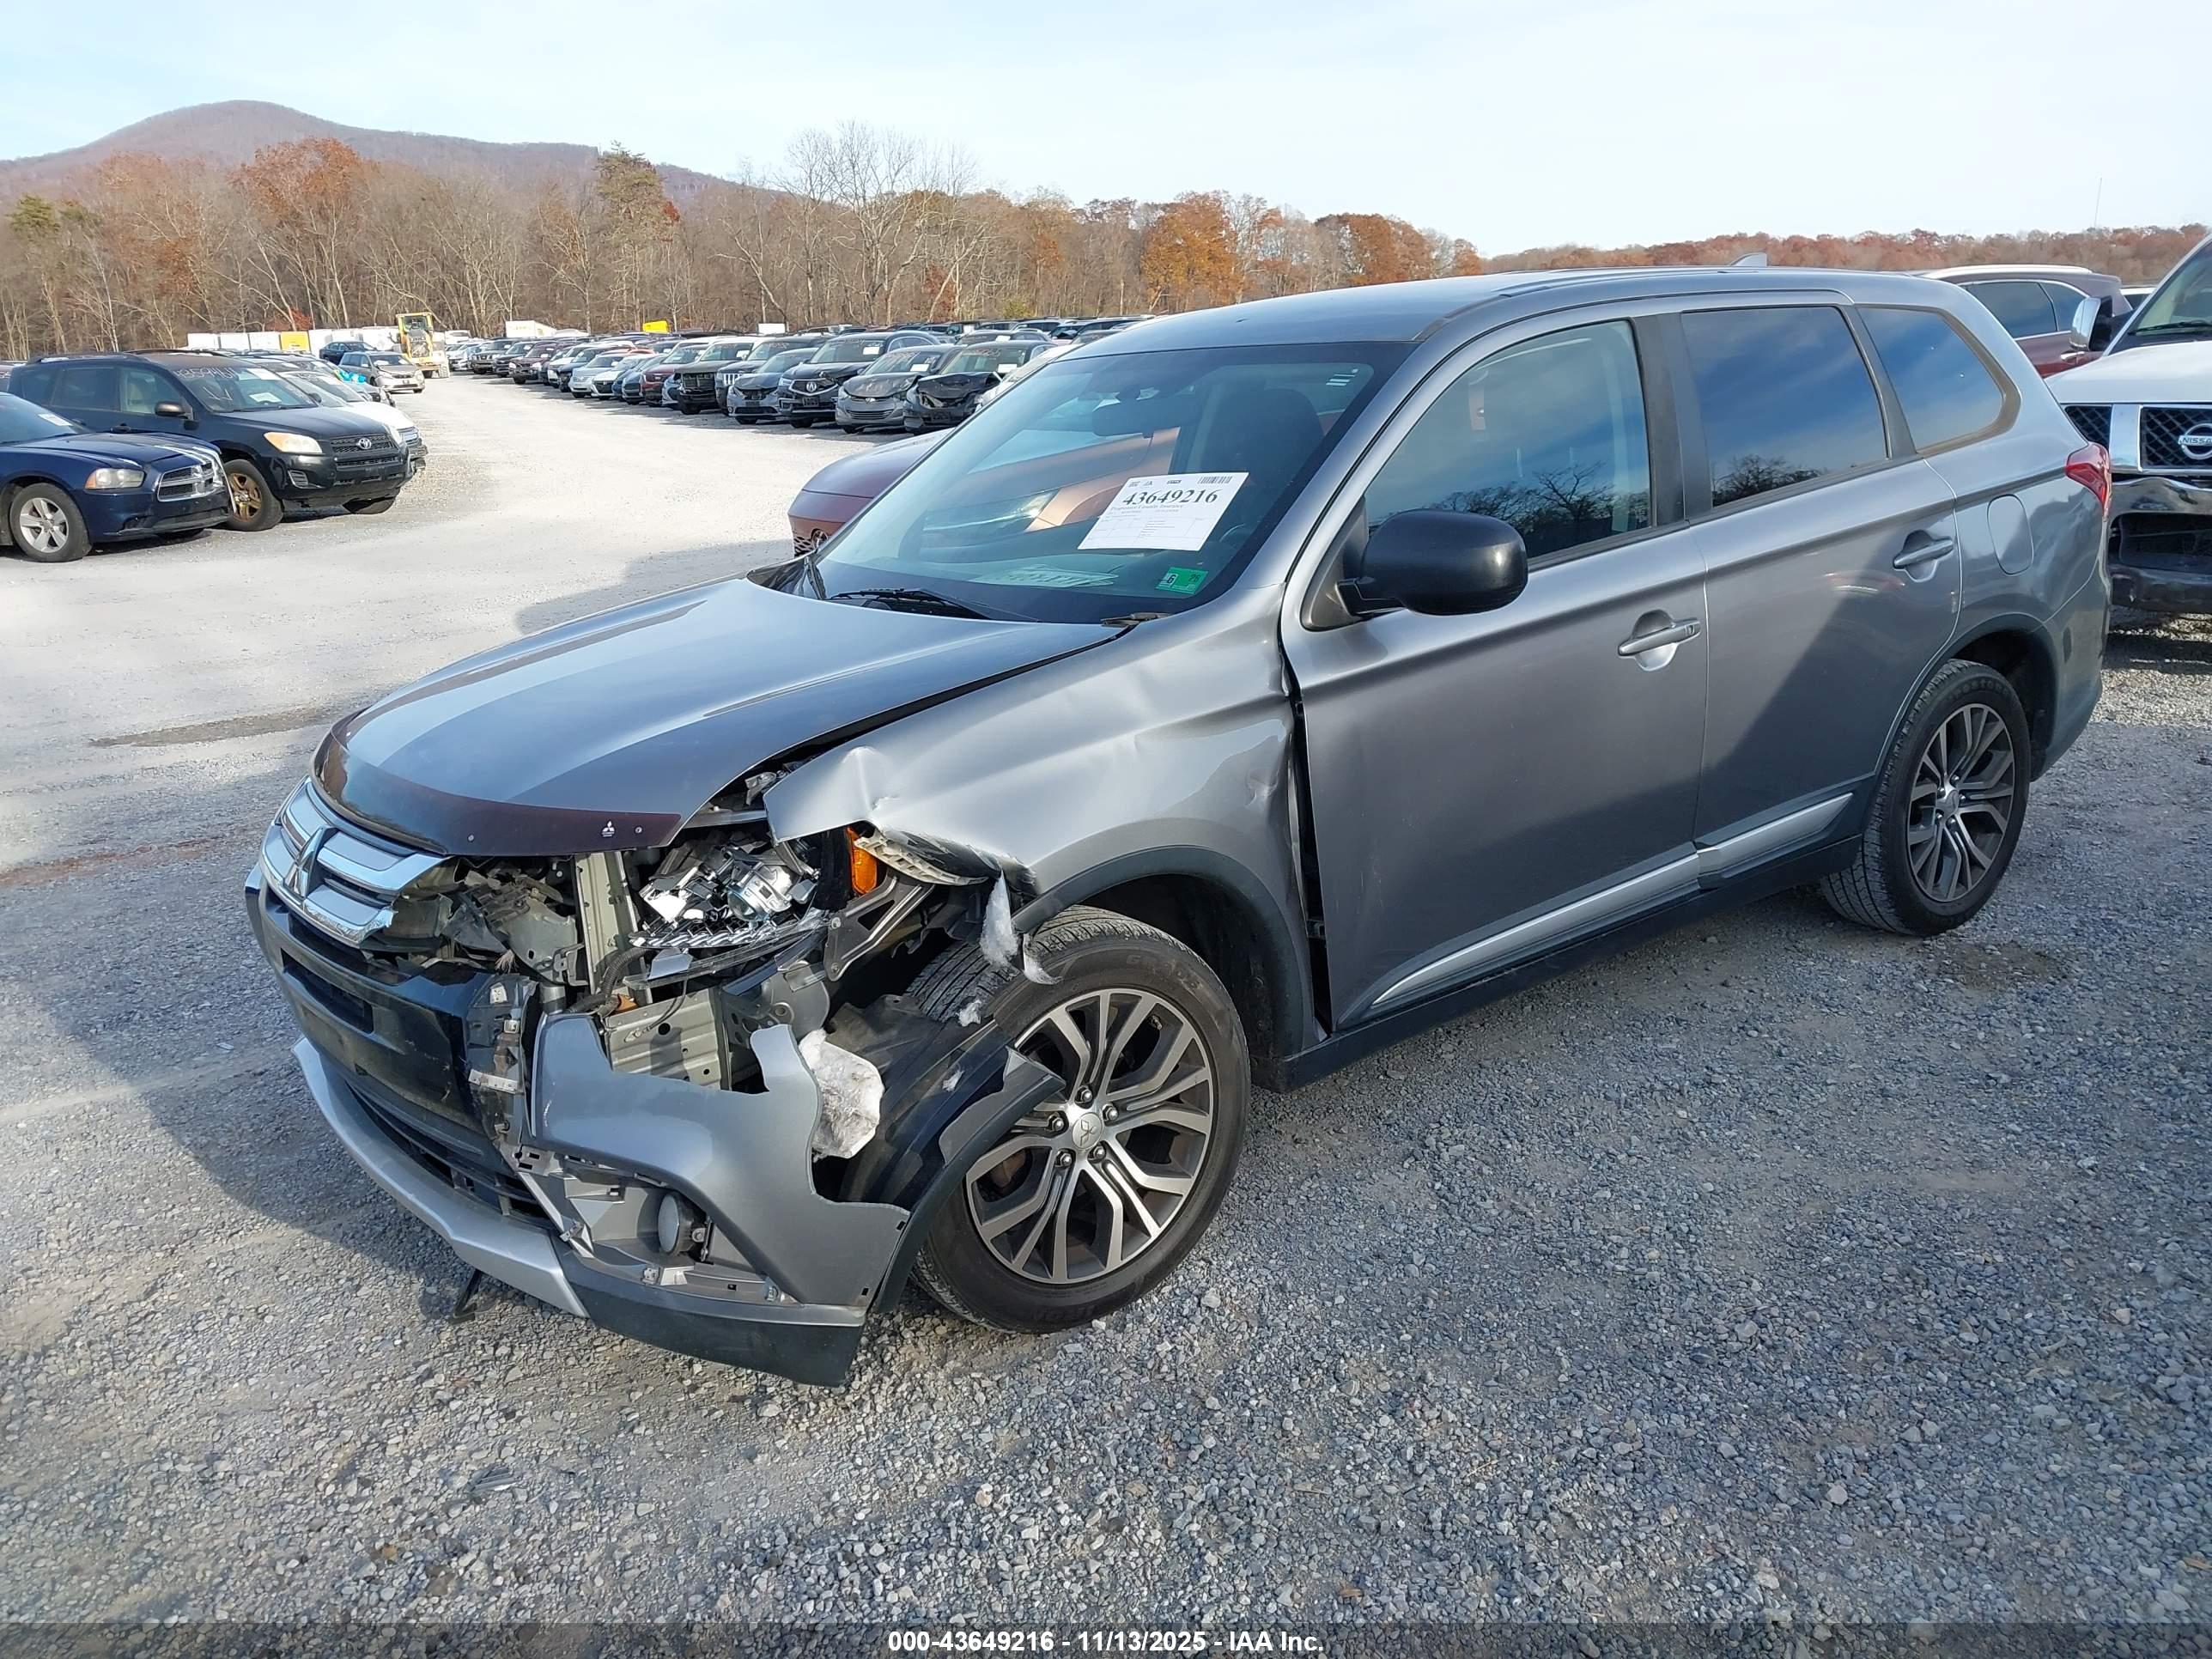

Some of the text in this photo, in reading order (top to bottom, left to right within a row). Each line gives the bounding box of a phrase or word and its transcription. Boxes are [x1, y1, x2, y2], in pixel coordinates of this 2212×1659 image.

[1123, 489, 1223, 505] 43649216
[1166, 574, 1176, 584] 6
[1188, 574, 1201, 582] 26
